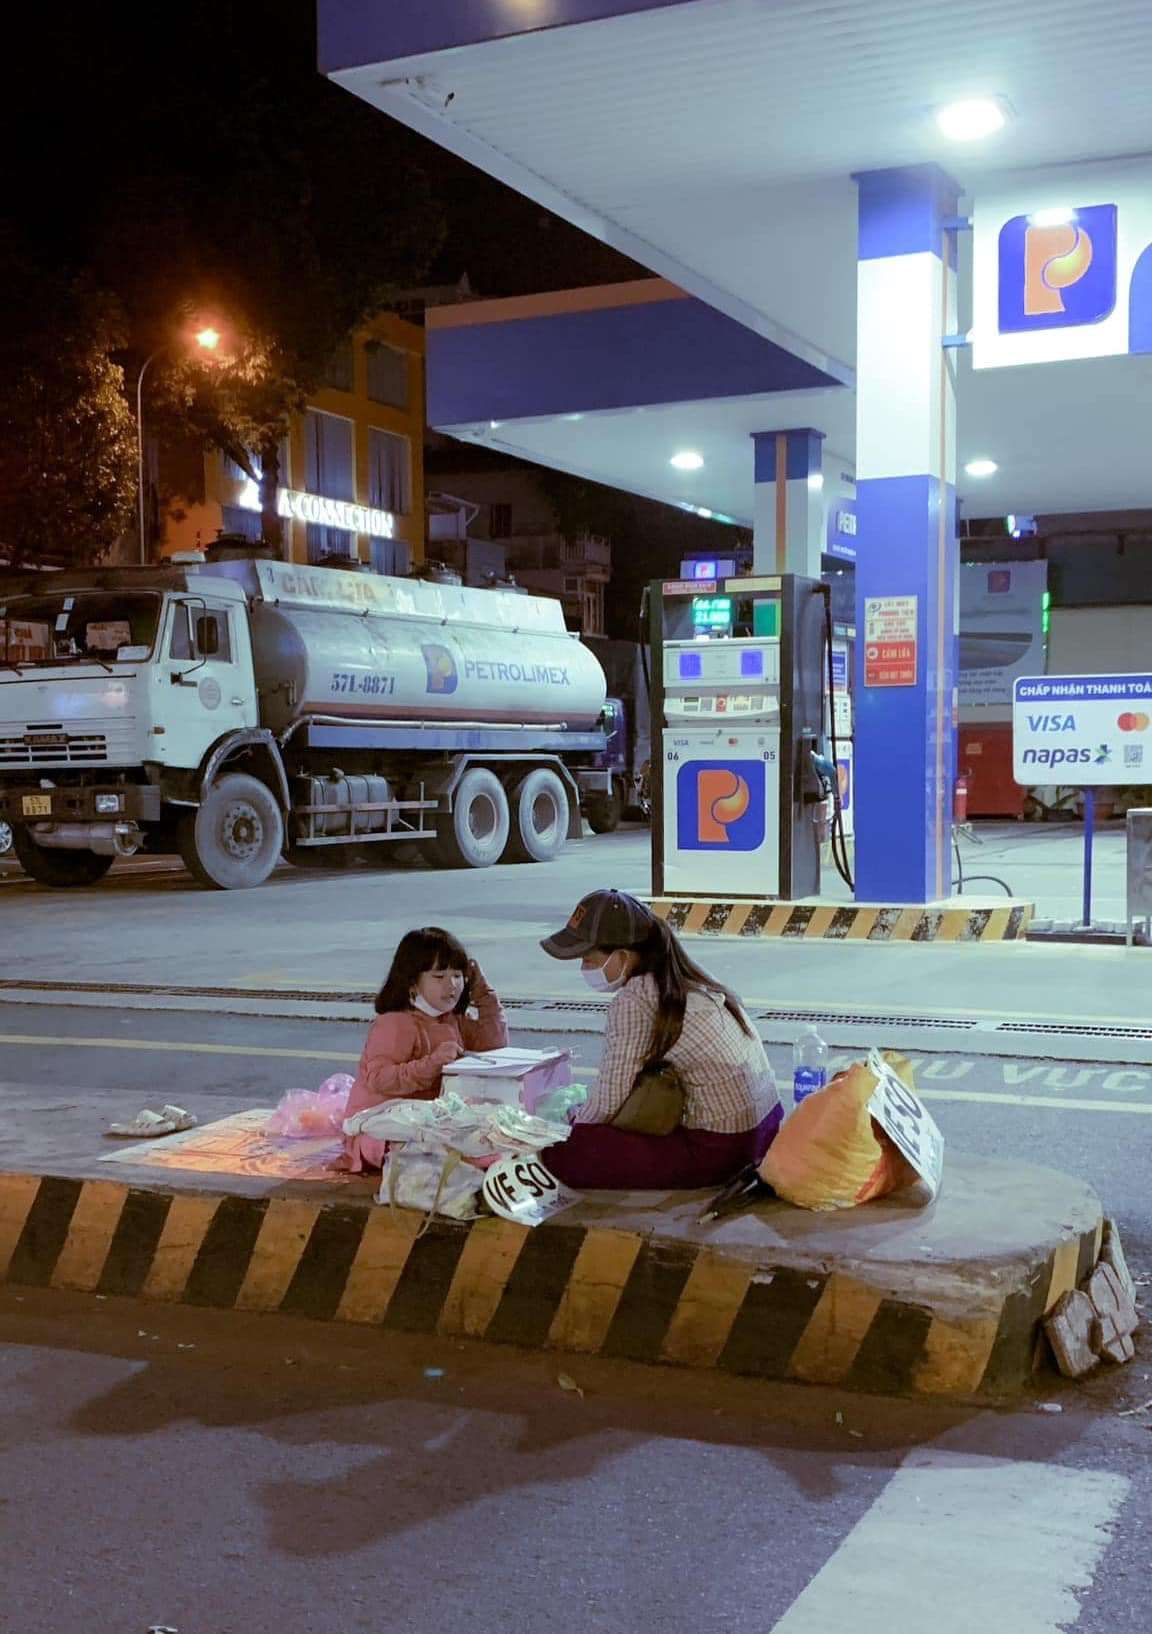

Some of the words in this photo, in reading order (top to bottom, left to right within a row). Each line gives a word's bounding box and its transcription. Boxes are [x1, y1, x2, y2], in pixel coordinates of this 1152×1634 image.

[464, 660, 570, 686] PETROLIMEX
[1086, 683, 1126, 695] THANH
[1025, 714, 1076, 732] VISA
[667, 752, 679, 760] 06
[763, 751, 776, 760] 05
[1022, 748, 1092, 769] napas
